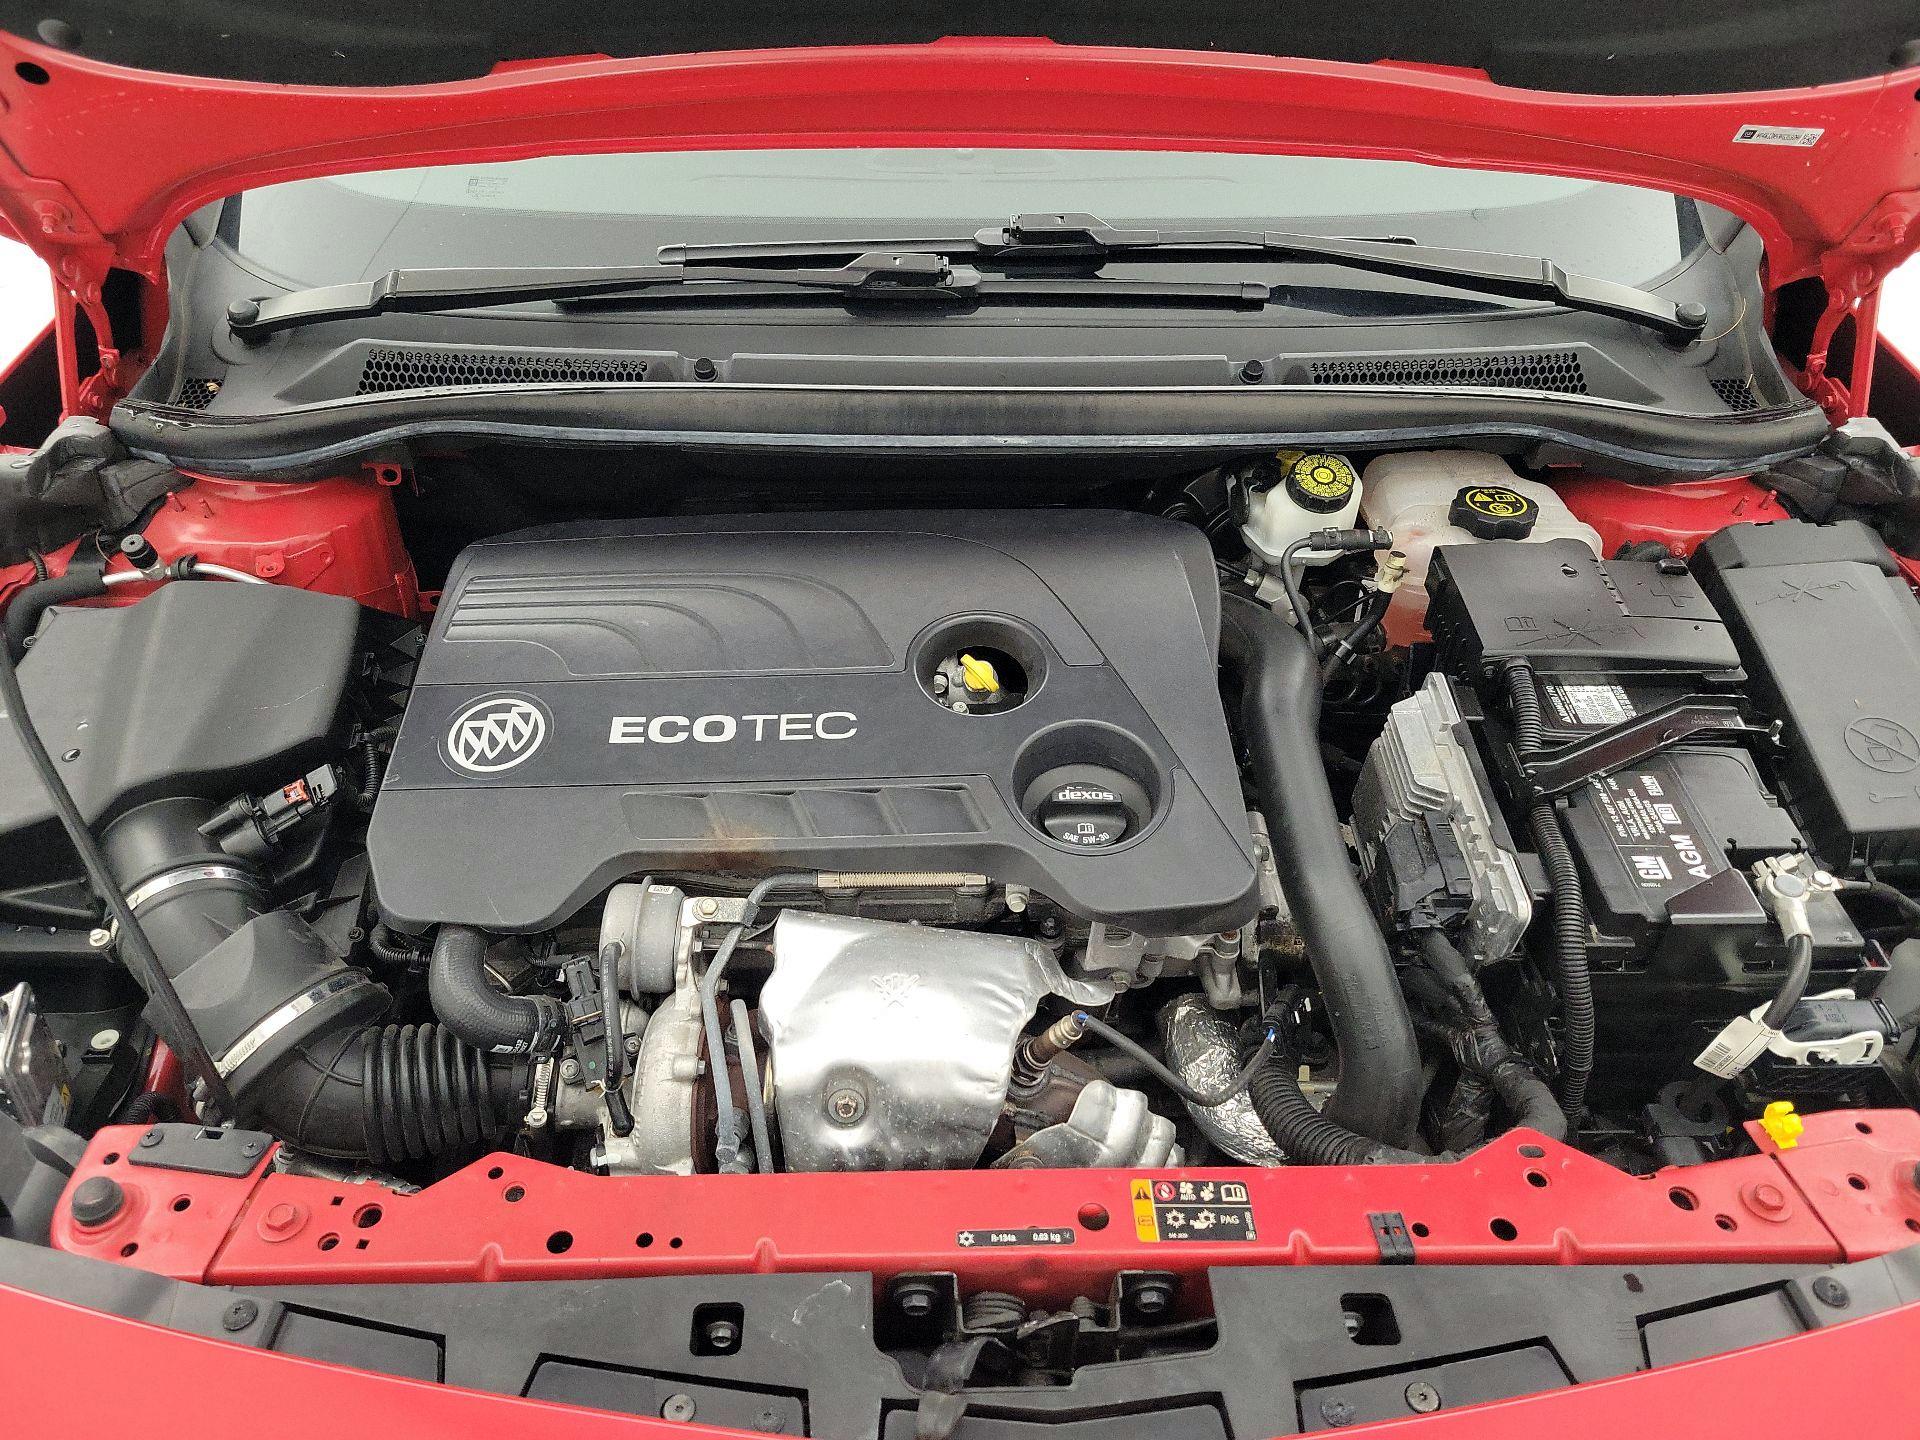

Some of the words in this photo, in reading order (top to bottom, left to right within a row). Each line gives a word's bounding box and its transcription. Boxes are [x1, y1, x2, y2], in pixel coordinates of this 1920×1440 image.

[608, 711, 858, 744] ECOTEC
[1058, 789, 1114, 800] dexos
[1062, 832, 1079, 843] SAE
[1082, 832, 1110, 844] 5W-30
[1669, 834, 1712, 880] AGM
[1630, 855, 1668, 880] GM
[1220, 1214, 1240, 1225] PAG
[1050, 1231, 1061, 1243] kg
